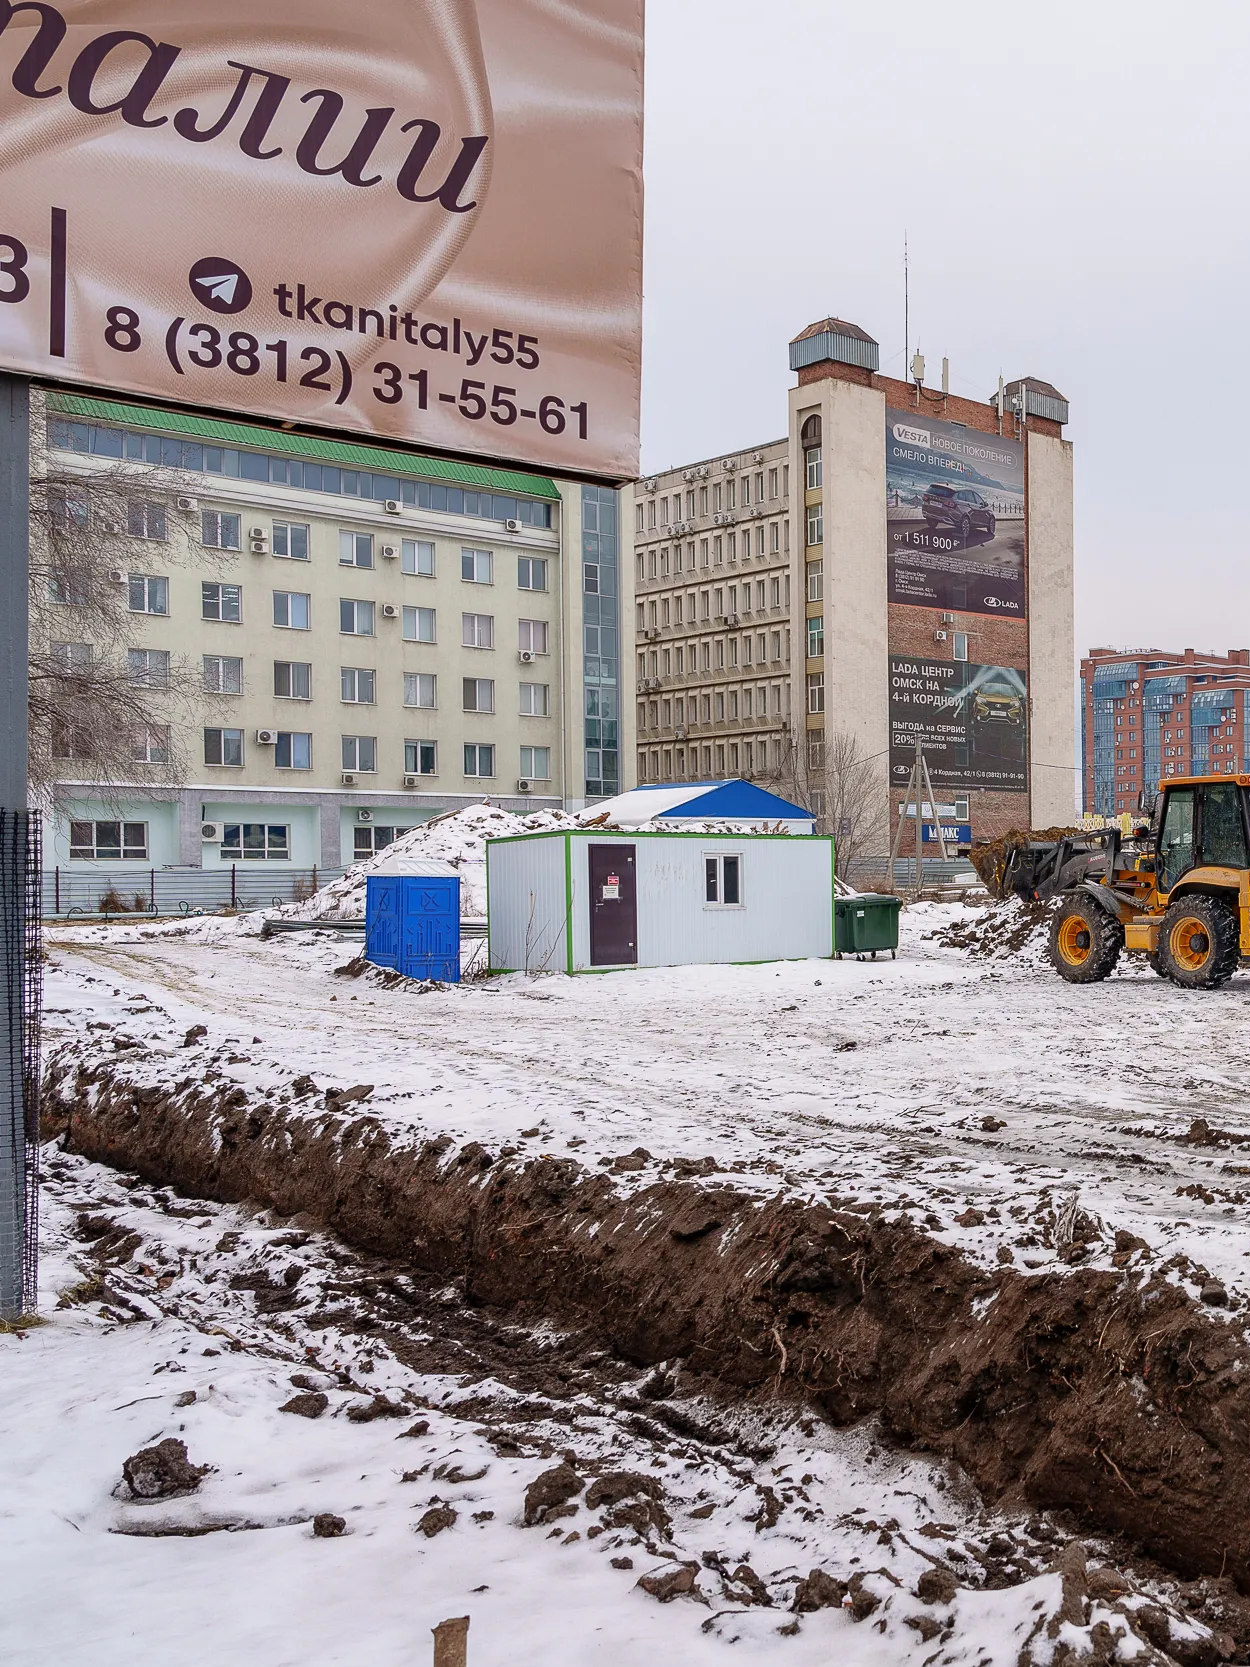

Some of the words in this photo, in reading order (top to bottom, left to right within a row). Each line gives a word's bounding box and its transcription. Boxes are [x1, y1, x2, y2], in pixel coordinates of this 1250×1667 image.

[273, 282, 541, 370] tkanitaly55
[104, 305, 142, 352] 8
[165, 317, 353, 405] (3812)
[372, 361, 589, 440] 31-55-61
[896, 427, 929, 444] VESTA
[893, 447, 926, 463] СМЕЛО
[932, 437, 962, 453] НОВОЕ
[963, 445, 1012, 465] ПОКОЛЕНИЕ
[913, 533, 929, 546] 511
[932, 536, 952, 550] 900
[1001, 600, 1019, 609] LADA
[892, 662, 919, 675] LADA
[921, 665, 954, 678] ЦЕНТР
[892, 677, 923, 690] ОМСК
[926, 680, 940, 691] НА
[892, 691, 910, 703] 4-й
[892, 721, 924, 731] ВЫГОДА
[936, 724, 966, 734] СЕРВИС
[894, 734, 915, 745] 20%
[920, 742, 947, 750] ЛИЕНТОВ
